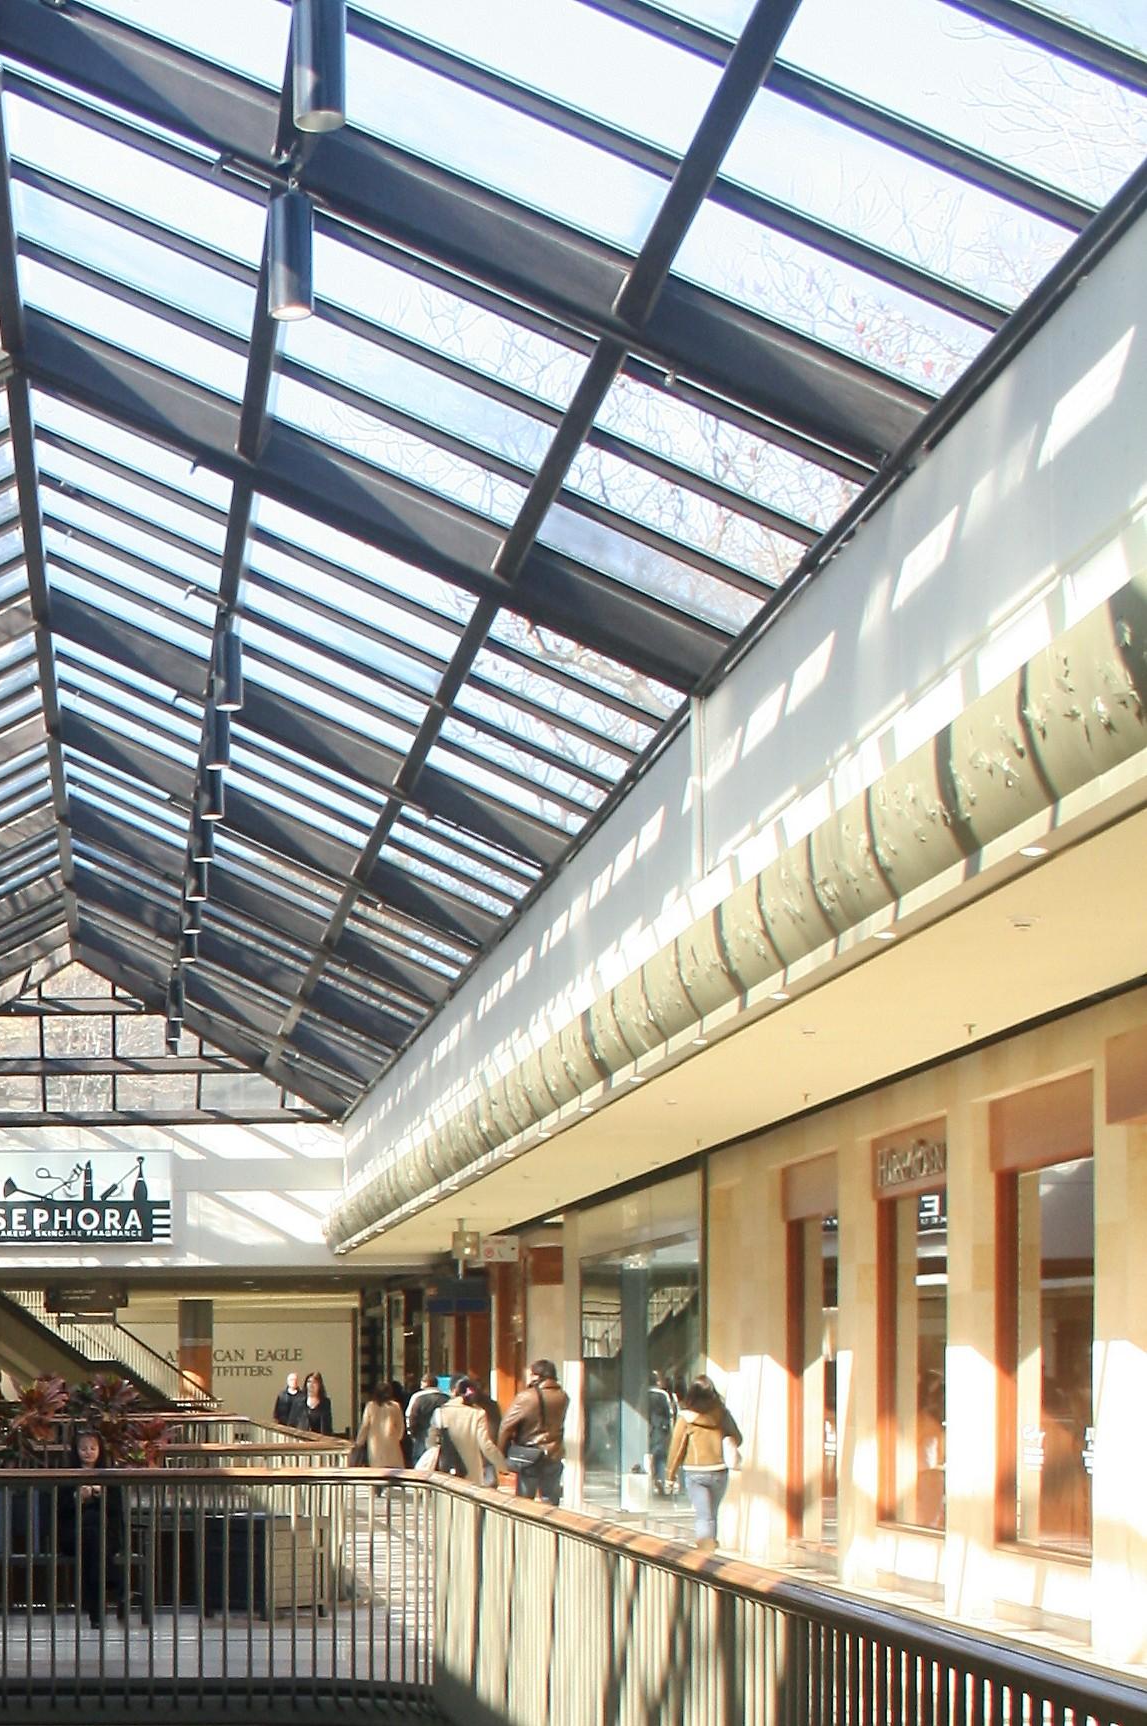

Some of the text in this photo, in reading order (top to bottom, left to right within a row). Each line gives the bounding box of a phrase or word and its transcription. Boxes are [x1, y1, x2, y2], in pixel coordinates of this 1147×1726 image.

[165, 1349, 302, 1362] ACAN EAGLE
[213, 1366, 272, 1377] TFITTERS
